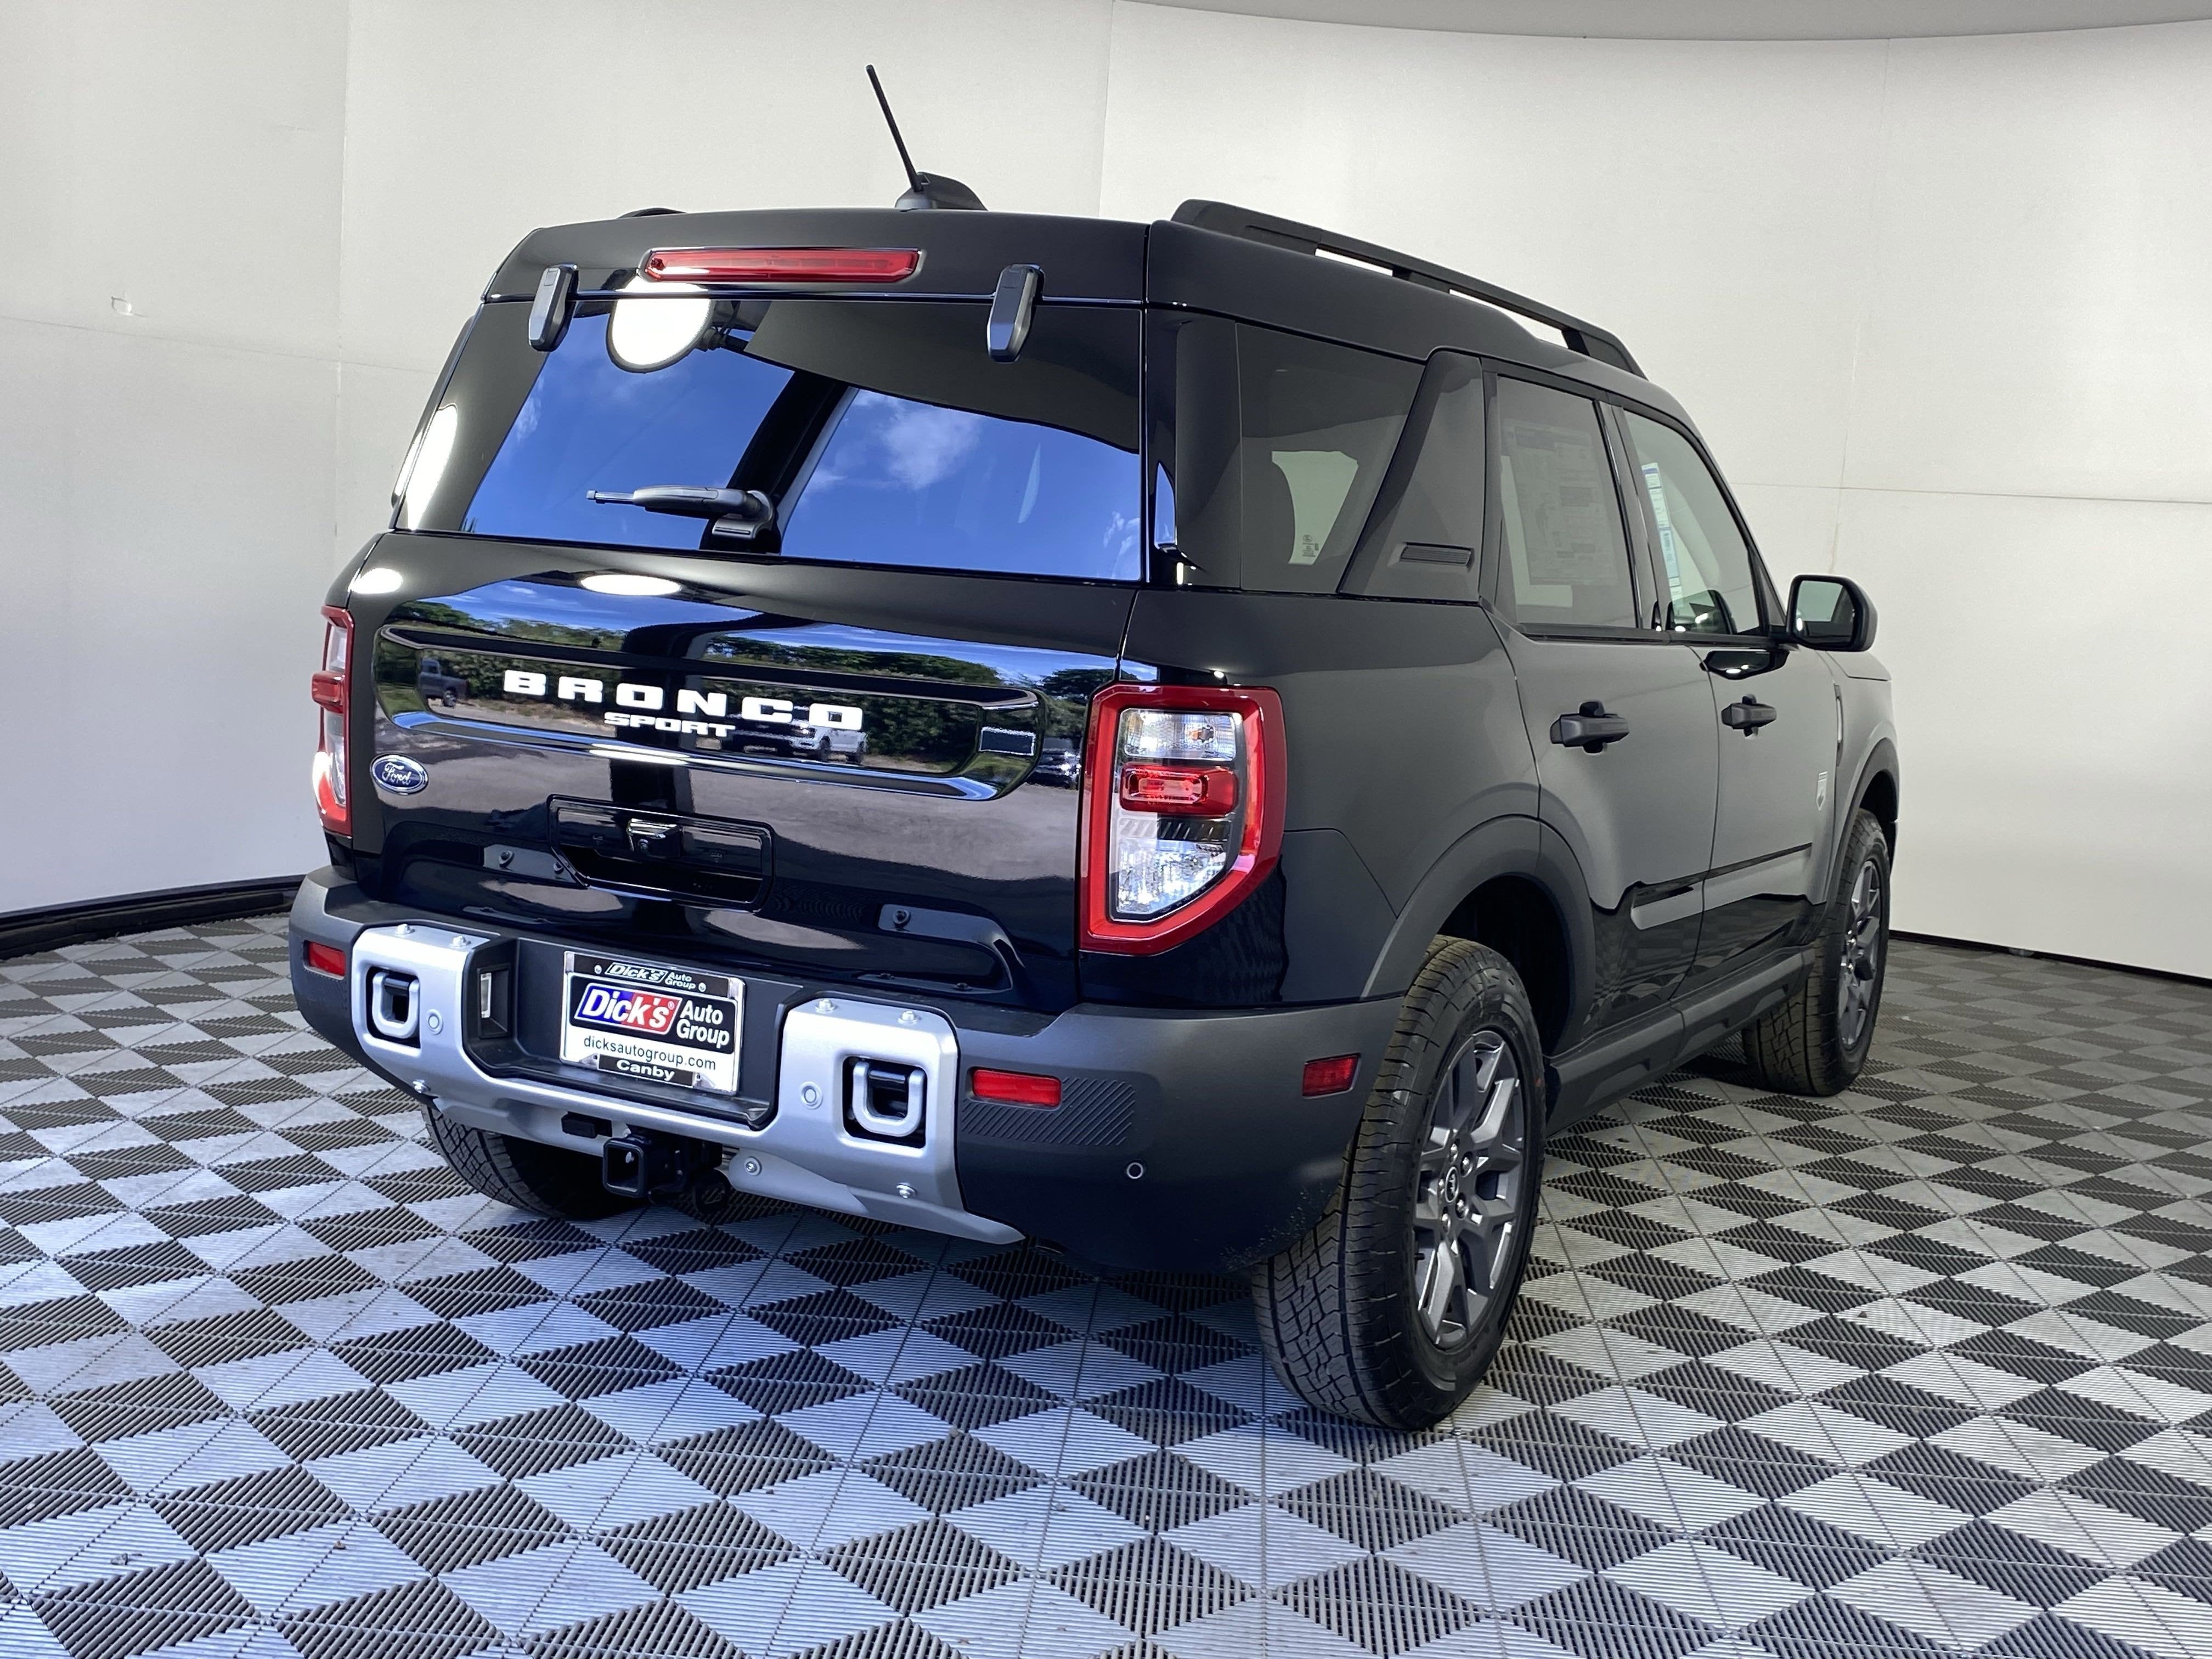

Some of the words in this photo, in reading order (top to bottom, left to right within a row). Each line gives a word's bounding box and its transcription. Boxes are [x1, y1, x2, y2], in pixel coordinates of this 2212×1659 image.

[503, 670, 862, 731] BRONCO
[604, 712, 736, 737] SPORT
[382, 762, 411, 785] Ford
[665, 978, 696, 990] Group
[667, 972, 692, 983] Auto
[582, 989, 670, 1029] Dick's
[680, 1000, 723, 1025] Auto
[676, 1019, 730, 1048] Group
[584, 1035, 716, 1070] dicksautogroup.com
[617, 1059, 675, 1081] Canby
